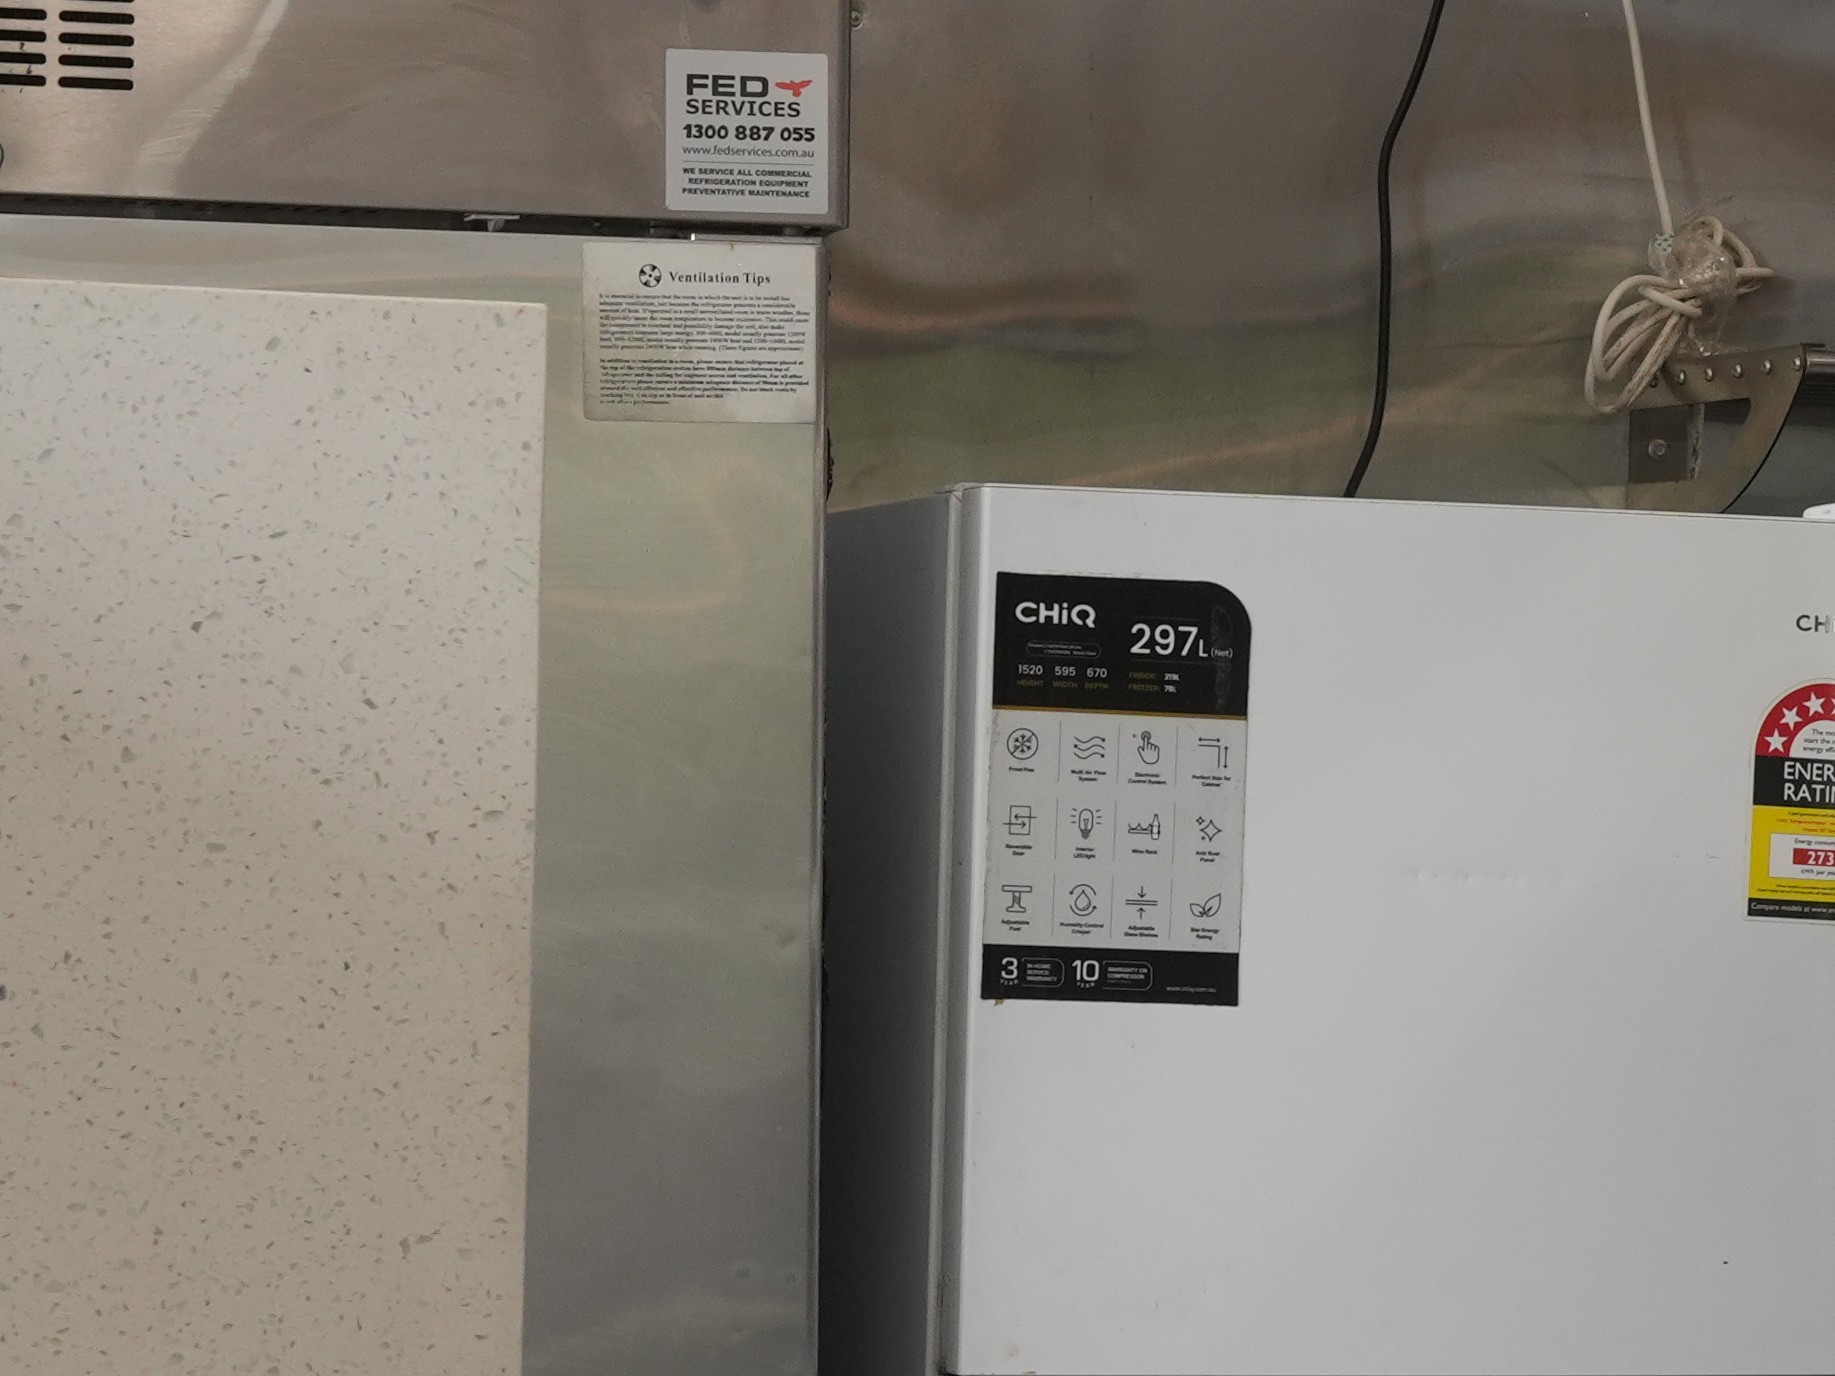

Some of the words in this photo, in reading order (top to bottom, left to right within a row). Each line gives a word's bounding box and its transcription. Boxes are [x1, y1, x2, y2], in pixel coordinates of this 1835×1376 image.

[687, 73, 769, 98] FED
[686, 98, 801, 118] SERVICES
[683, 124, 729, 139] 1300
[734, 125, 775, 141] 887
[780, 126, 815, 142] 055
[683, 144, 814, 158] www.fedservices.com.au
[683, 167, 696, 175] WE
[698, 168, 734, 176] SERVICE
[755, 169, 812, 177] COMMERCIAL
[688, 178, 756, 187] REFRIGERATION
[759, 179, 809, 187] EQUIPMENT
[682, 188, 745, 196] PREVENTATIVE
[748, 188, 810, 198] MAINTENANCE
[669, 271, 739, 284] Ventilation
[743, 272, 771, 286] Tips
[1015, 601, 1097, 629] CHiQ
[1018, 664, 1043, 675] 1520
[1054, 666, 1076, 677] 595
[1087, 667, 1108, 678] 670
[1812, 728, 1824, 736] The
[1794, 838, 1813, 846] Energy
[1808, 851, 1834, 866] 273
[1751, 902, 1780, 911] Compare
[1781, 904, 1802, 912] models
[1000, 957, 1018, 979] 3
[1072, 960, 1099, 982] 10
[999, 978, 1019, 986] YEAR
[1076, 981, 1096, 989] YEAR
